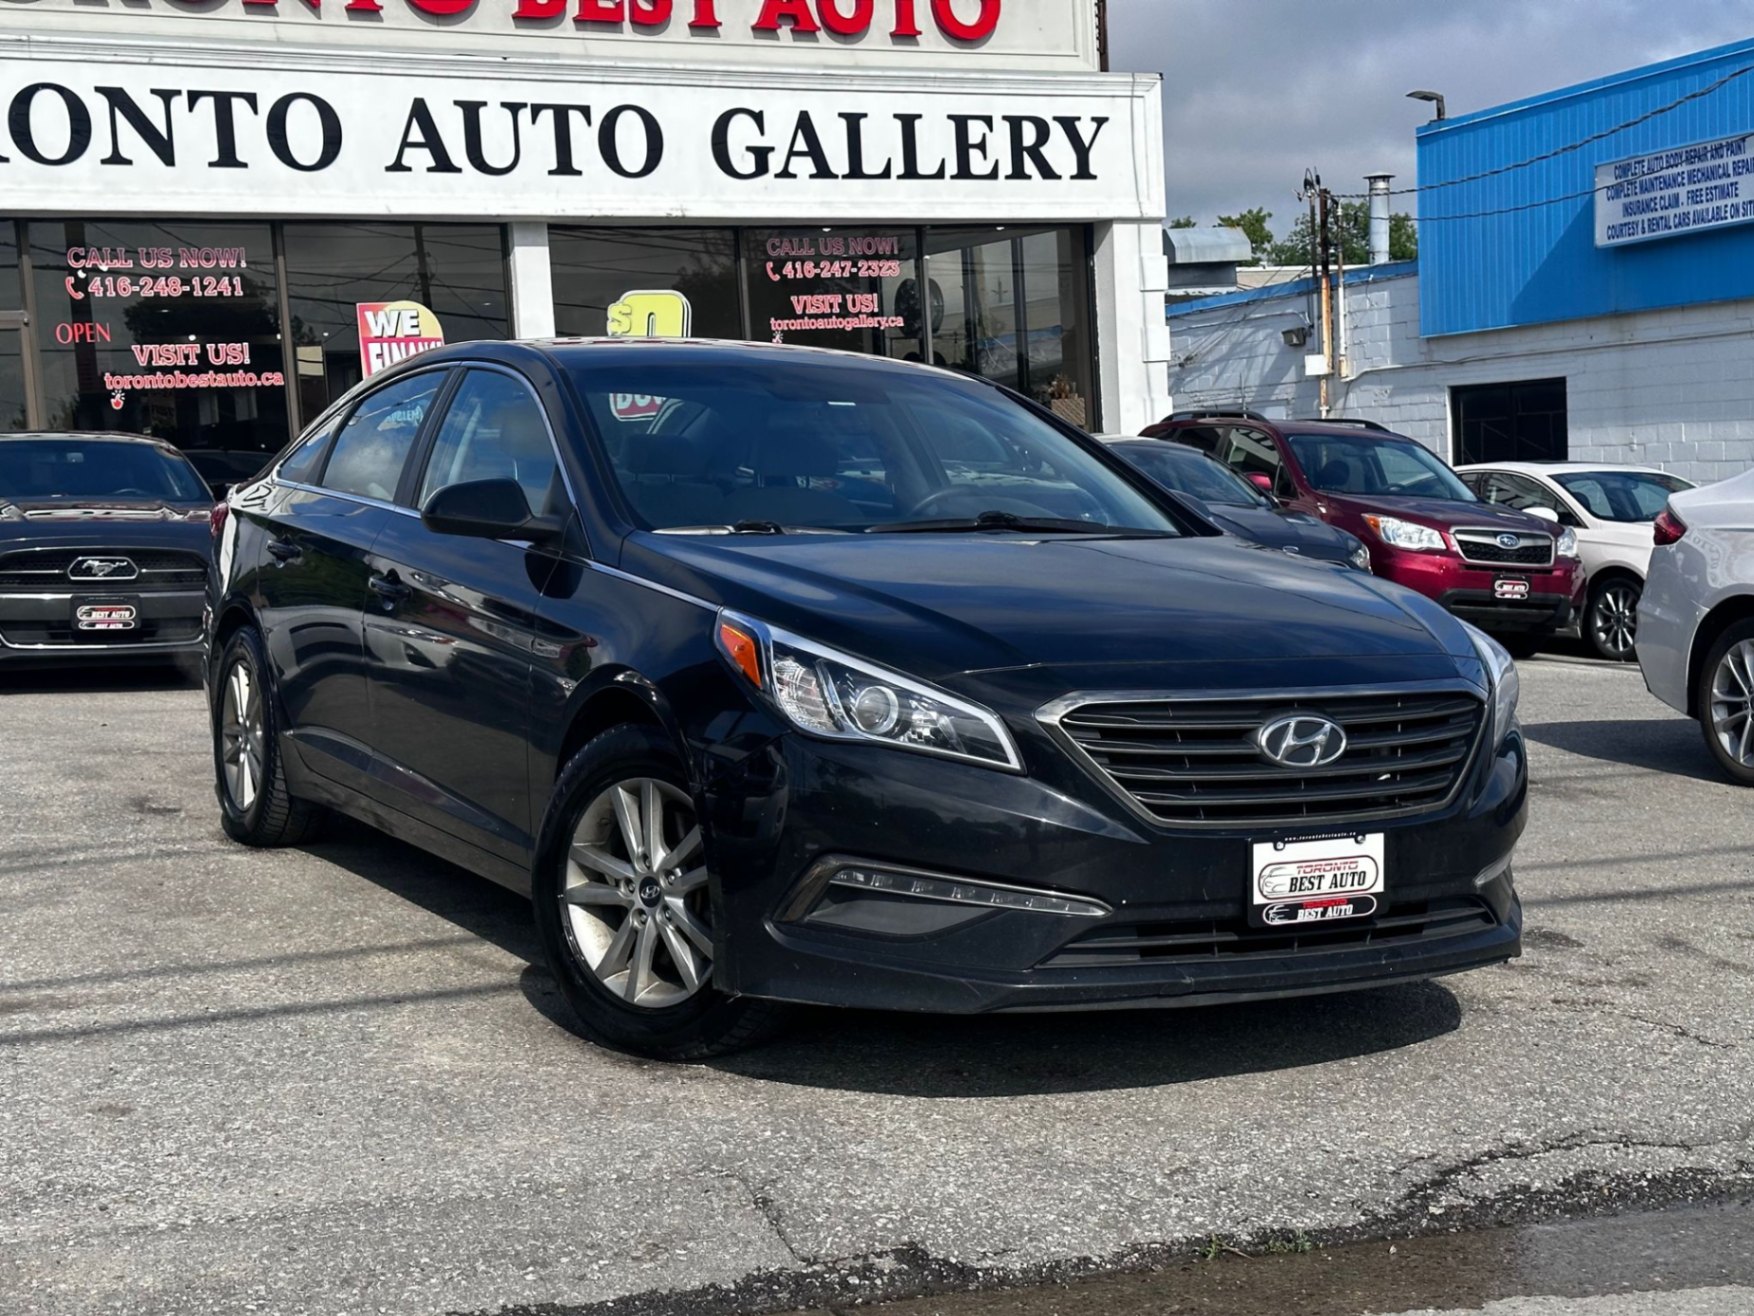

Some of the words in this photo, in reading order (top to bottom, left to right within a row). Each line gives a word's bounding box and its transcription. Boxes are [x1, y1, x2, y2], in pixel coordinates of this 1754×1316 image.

[0, 82, 342, 172] ONTO
[384, 97, 664, 179] AUTO
[711, 107, 1109, 180] GALLERY
[1614, 159, 1645, 180] COMPLETE
[1647, 155, 1664, 173] AUTO
[1665, 151, 1683, 169] BODY
[1710, 142, 1724, 160] AND
[1726, 138, 1745, 157] PAINT
[1606, 180, 1638, 201] COMPLETE
[1639, 171, 1685, 195] MAINTENANCE
[1687, 161, 1731, 185] MECHANICAL
[1622, 196, 1658, 218] INSURANCE
[1686, 188, 1704, 206] FREE
[1705, 181, 1739, 203] ESTIMATE
[1606, 220, 1639, 240] COURTESY
[1641, 218, 1646, 234] &
[1647, 214, 1672, 234] RENTAL
[1673, 210, 1691, 229] CARS
[1692, 204, 1728, 226] AVAILABLE
[1730, 202, 1741, 220] ON
[1741, 199, 1754, 218] SIT
[766, 237, 815, 256] CALL
[819, 237, 845, 255] US
[848, 236, 898, 255] NOW!
[67, 247, 133, 268] CALL
[138, 247, 173, 268] US
[179, 247, 247, 268] NOW!
[782, 260, 900, 278] 416-247-2323
[88, 276, 243, 298] 416-248-1241
[791, 294, 842, 314] VISIT
[846, 293, 879, 313] US!
[55, 322, 111, 344] OPEN
[364, 310, 420, 337] WE
[770, 314, 904, 331] torontoautogallery.ca
[132, 344, 200, 366] VISIT
[206, 342, 250, 365] US!
[104, 370, 284, 390] torontobestauto.ca
[1297, 860, 1359, 875] TORONTO
[1288, 874, 1325, 893] BEST
[1329, 870, 1366, 889] AUTO
[1297, 907, 1324, 921] BEST
[1325, 904, 1353, 918] AUTO
